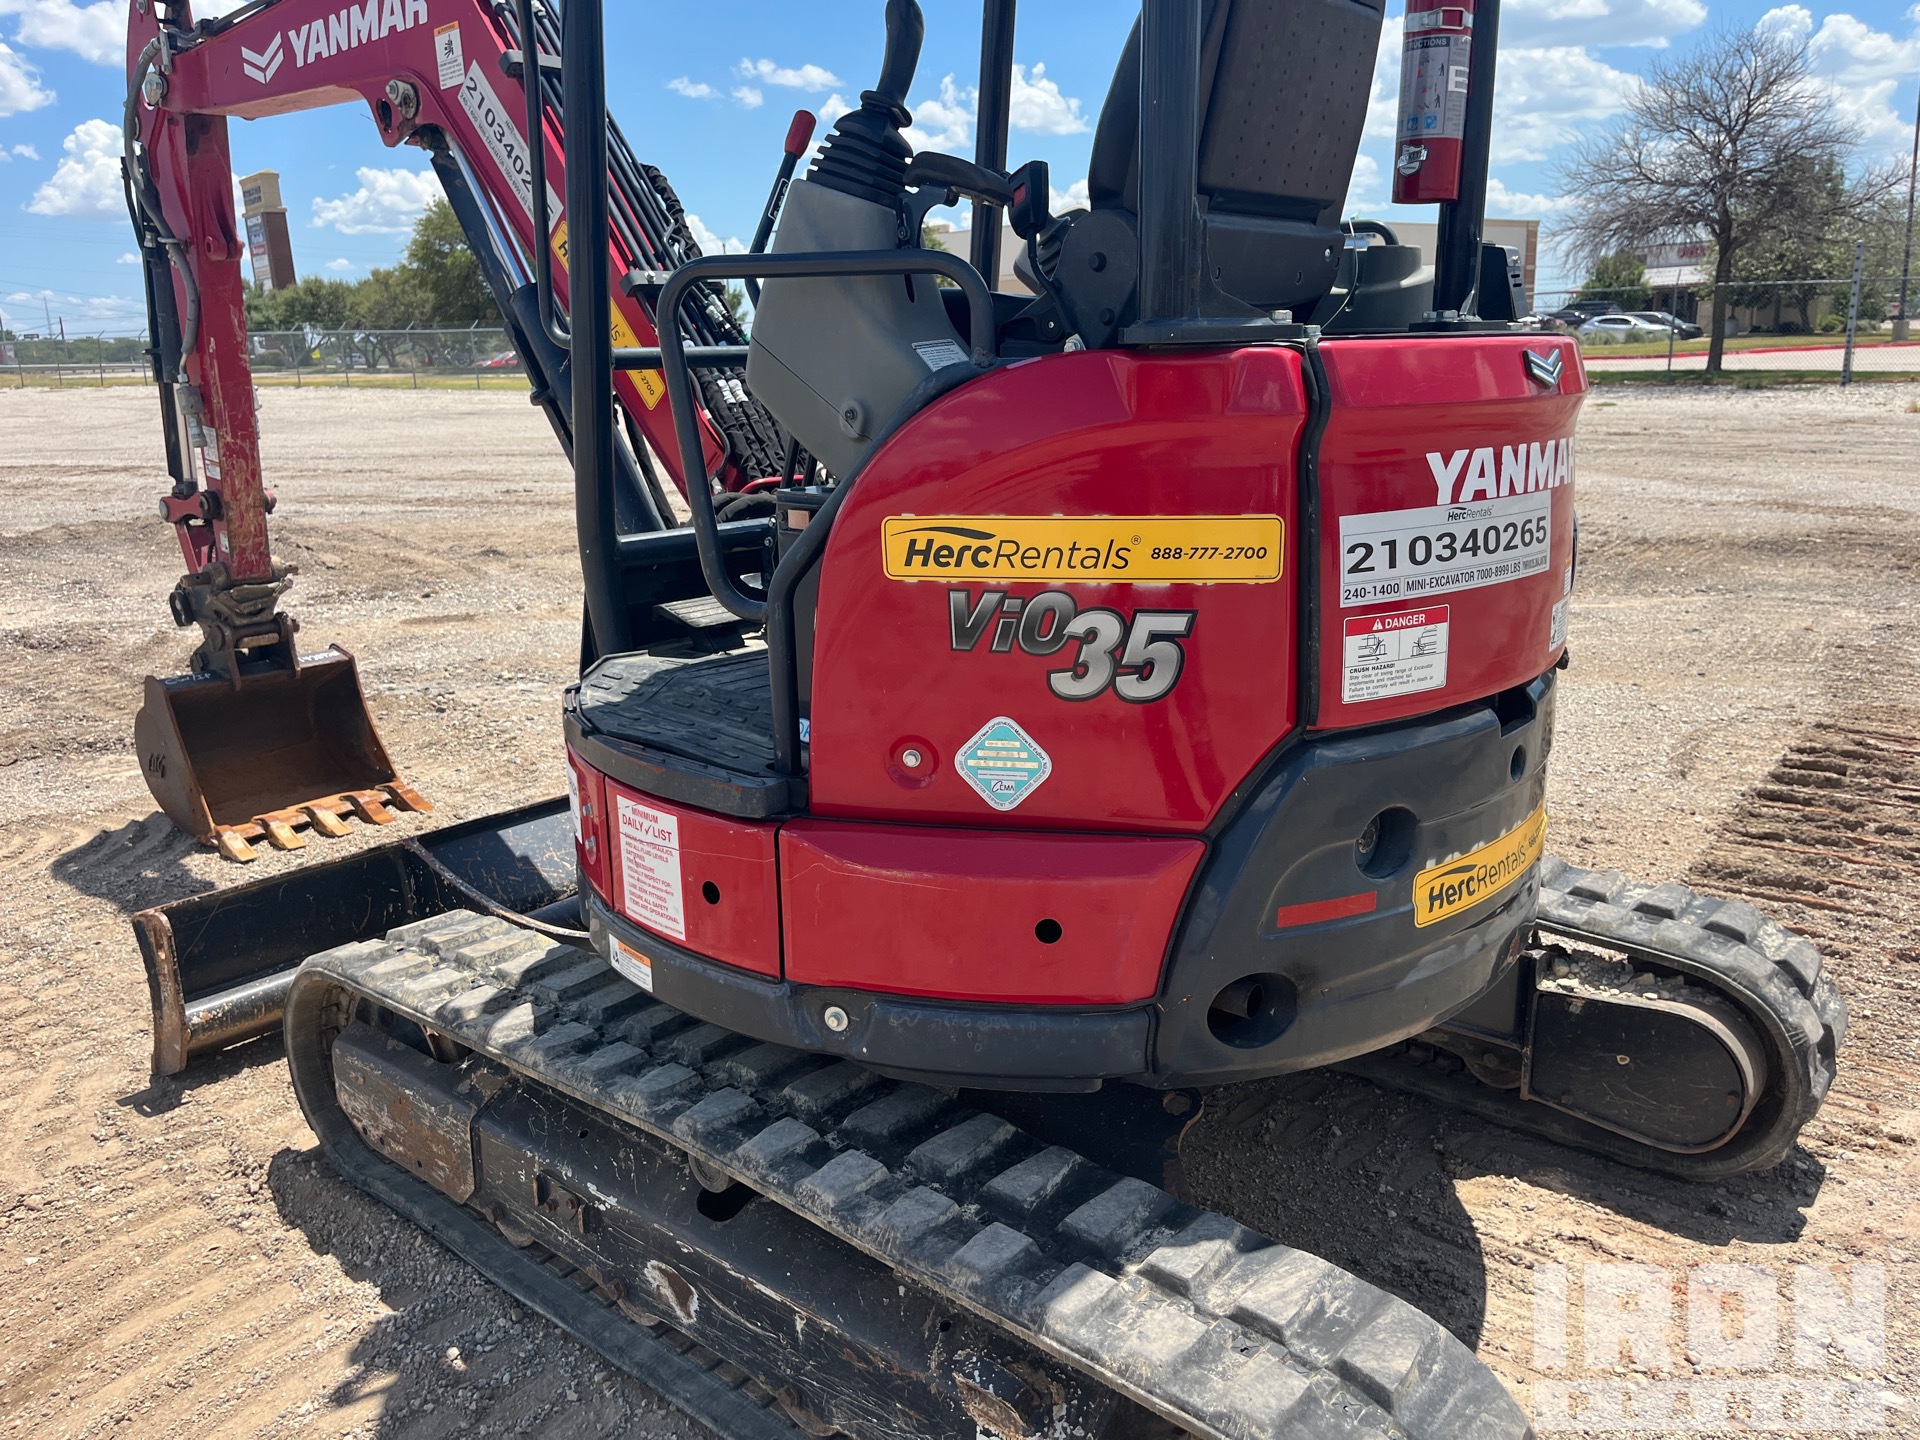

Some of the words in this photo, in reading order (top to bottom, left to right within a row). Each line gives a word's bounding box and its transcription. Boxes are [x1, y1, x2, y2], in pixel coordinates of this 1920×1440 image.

[288, 0, 428, 68] YANMAR
[1446, 505, 1492, 521] HercRentals
[904, 538, 1132, 570] HercRentals
[1150, 546, 1268, 561] 888-777-2700
[1347, 515, 1546, 574] 210340265
[1343, 580, 1399, 602] 240-1400
[1406, 569, 1474, 593] MINI-EXCAVATOR
[1476, 564, 1509, 580] 7000-8999
[1510, 561, 1520, 573] LBS
[1385, 613, 1426, 629] DANGER
[1371, 663, 1395, 671] HAZARD!
[981, 729, 990, 739] New
[622, 814, 643, 832] DAILY
[653, 826, 672, 842] LIST
[631, 807, 659, 824] MINIMUM
[1428, 843, 1526, 914] HercRentals
